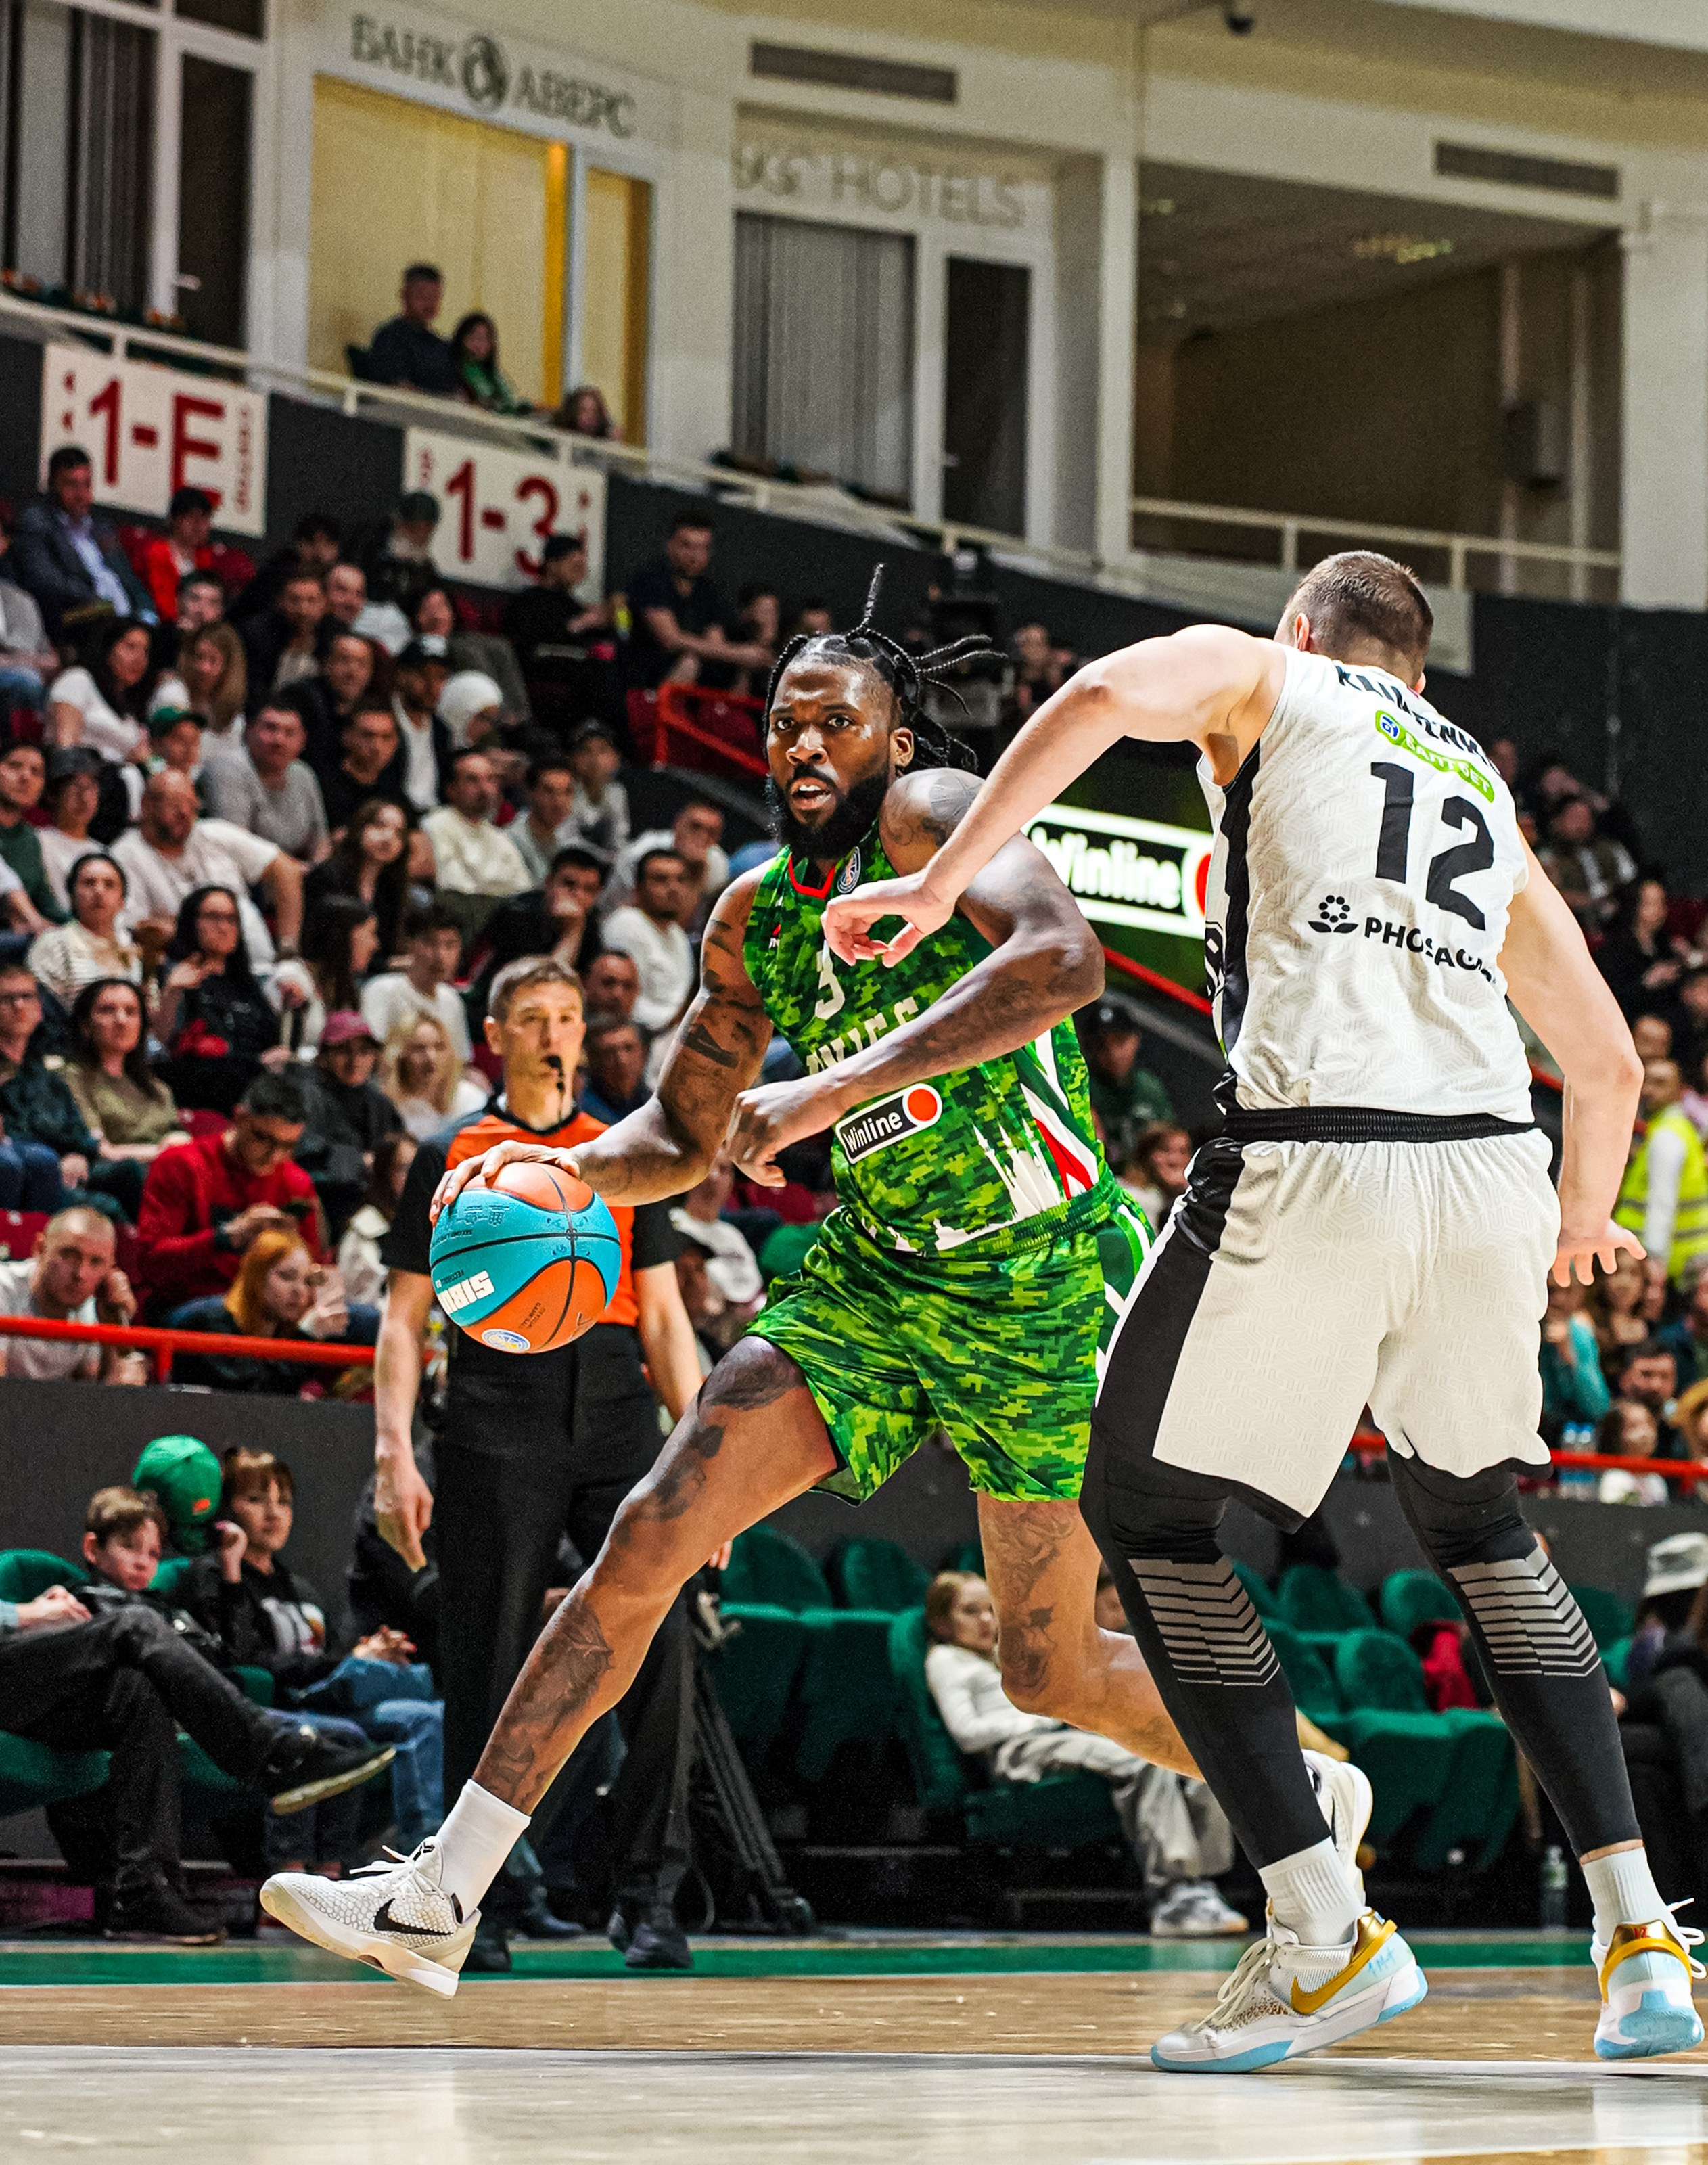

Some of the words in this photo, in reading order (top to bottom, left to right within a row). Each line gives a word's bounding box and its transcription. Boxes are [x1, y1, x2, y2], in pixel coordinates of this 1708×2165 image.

[831, 153, 1026, 229] HOTELS
[1030, 825, 1182, 910] Winline
[1370, 762, 1494, 931] 12
[842, 1111, 904, 1153] Winline
[436, 1269, 495, 1315] SIBU
